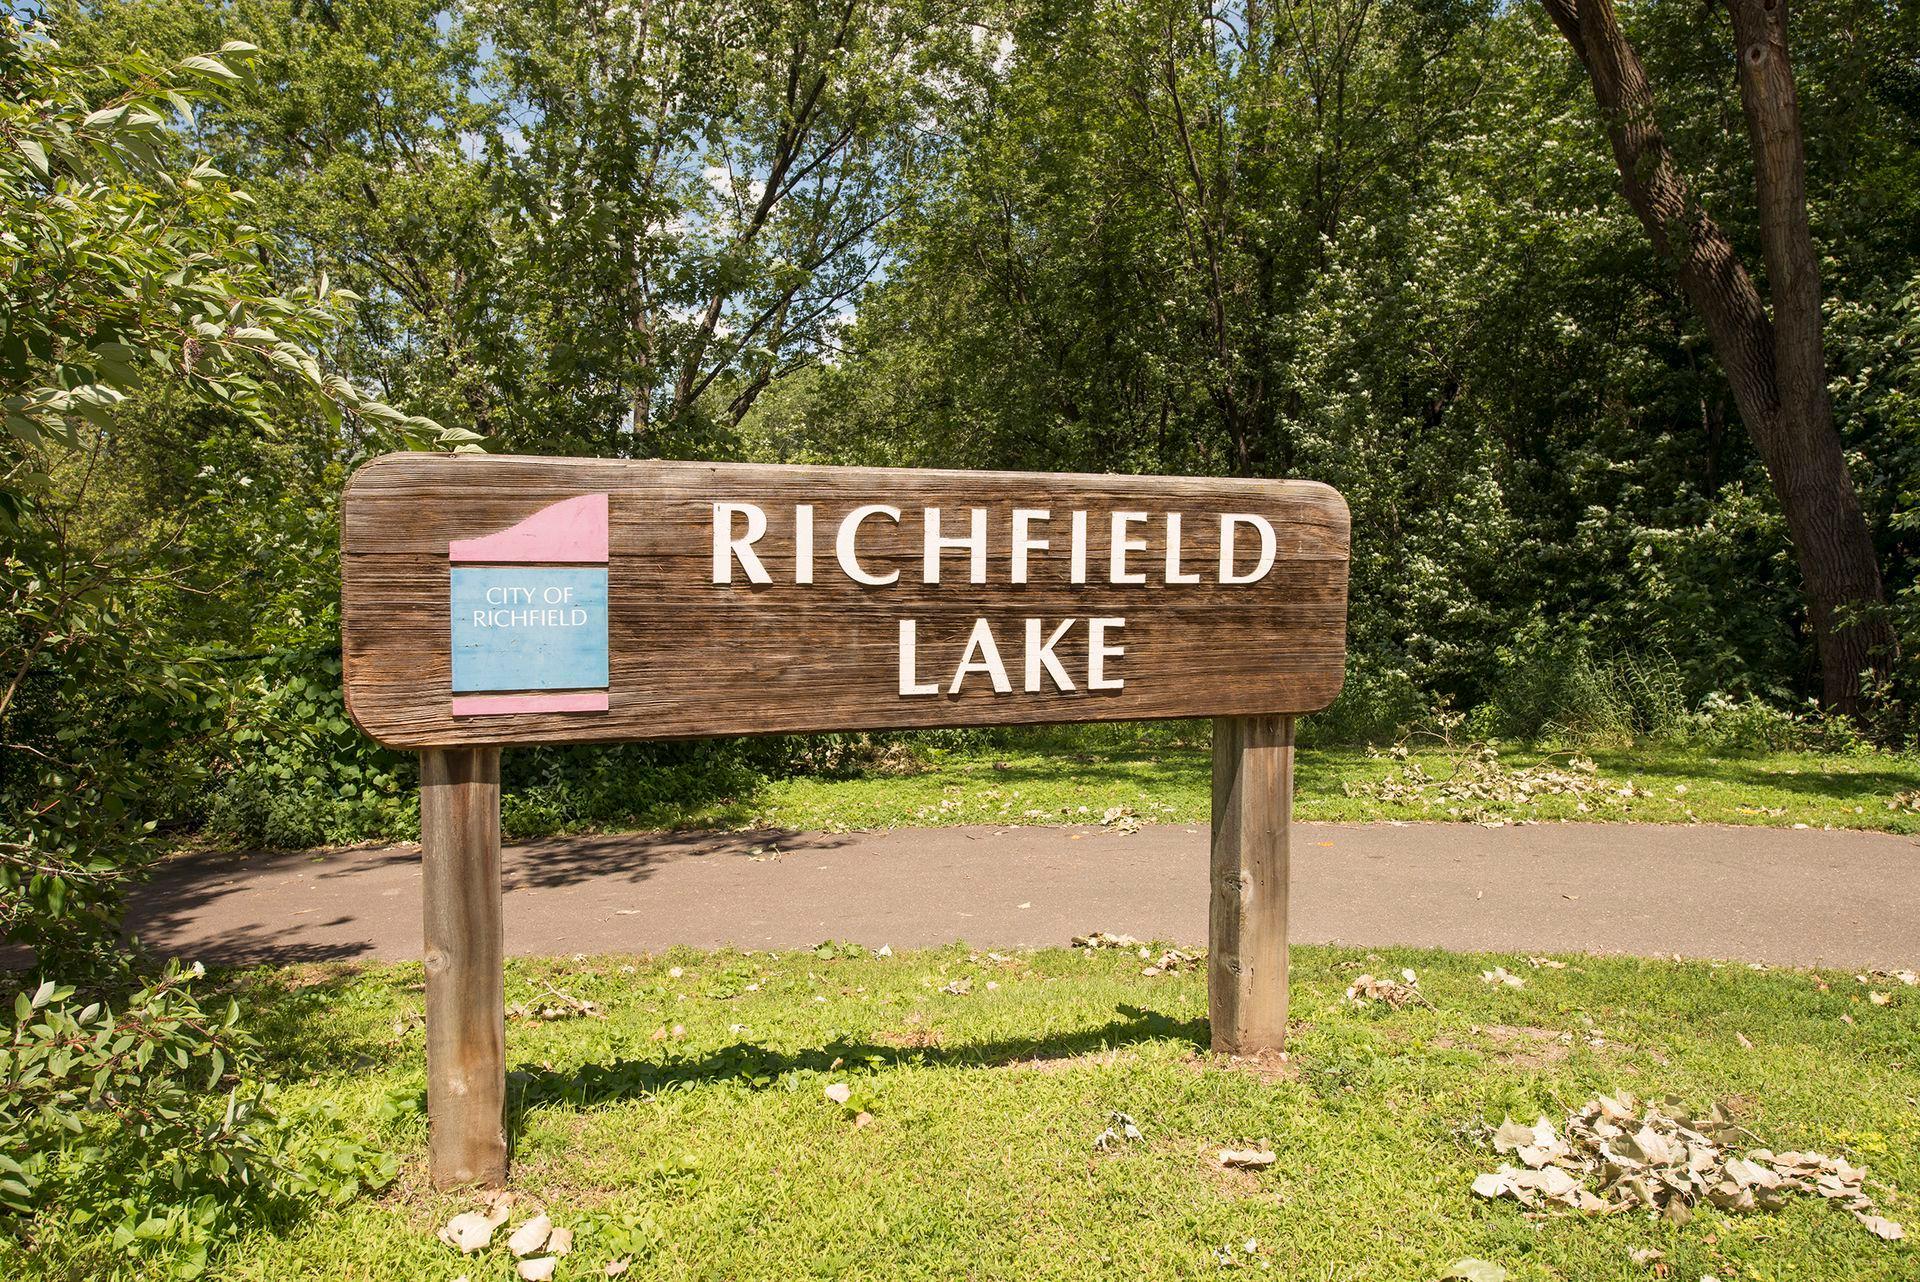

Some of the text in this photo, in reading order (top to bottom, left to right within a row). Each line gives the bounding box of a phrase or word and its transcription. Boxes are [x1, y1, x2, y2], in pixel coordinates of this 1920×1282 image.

[711, 502, 1278, 587] RICHFIELD
[473, 609, 588, 628] RICHFIELD
[486, 586, 574, 605] CITY OF
[897, 616, 1127, 696] LAKE
